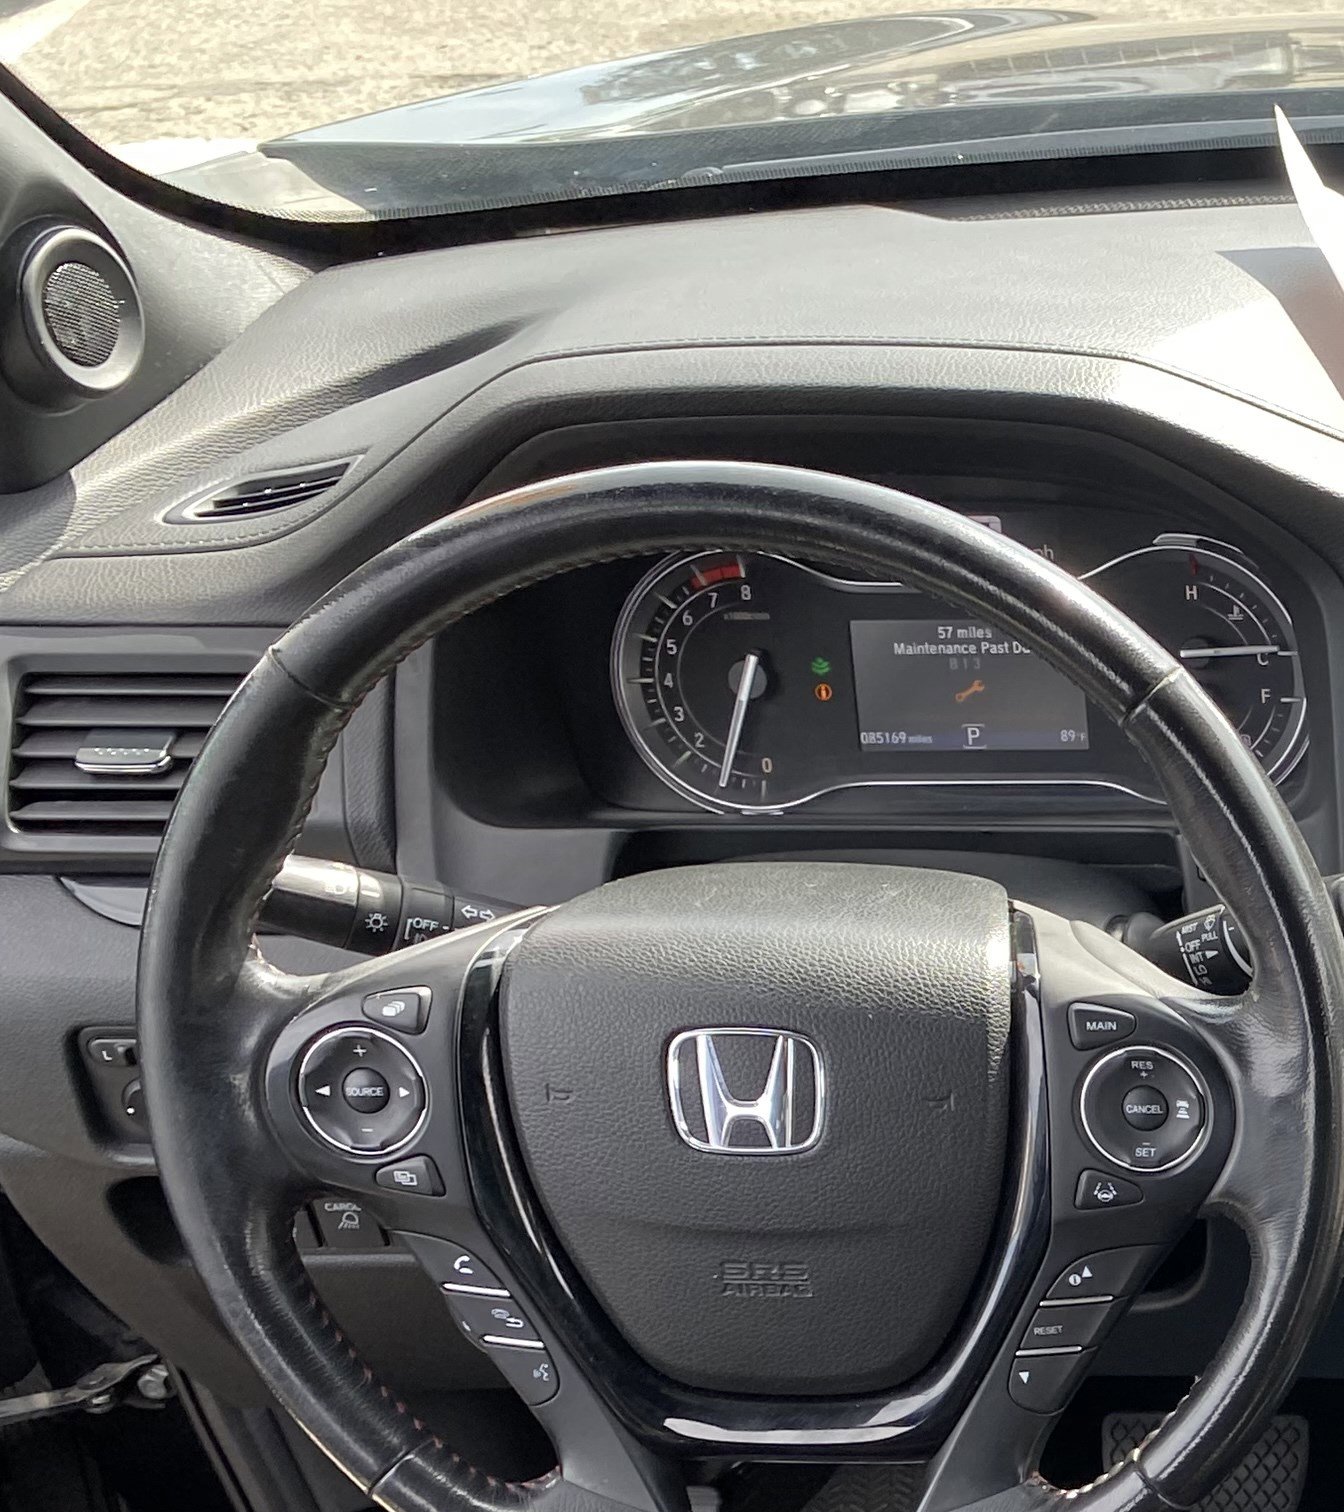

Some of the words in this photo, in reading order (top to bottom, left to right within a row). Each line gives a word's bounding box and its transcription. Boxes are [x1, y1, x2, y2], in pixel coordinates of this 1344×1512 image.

[740, 585, 751, 600] 8
[1185, 585, 1197, 600] H
[708, 592, 718, 608] 7
[682, 612, 693, 626] 6
[937, 626, 952, 639] 57
[957, 626, 992, 639] miles
[666, 639, 677, 654] 5
[894, 642, 976, 655] Maintenance
[981, 641, 1009, 654] Past
[664, 673, 673, 688] 4
[1260, 688, 1270, 703] F
[674, 706, 685, 722] 3
[694, 732, 705, 748] 2
[967, 727, 979, 745] P
[761, 757, 772, 773] 0
[413, 918, 439, 931] OFF
[1201, 931, 1218, 942] PULL
[1185, 939, 1200, 952] OFF
[1086, 1021, 1116, 1031] MAIN
[1131, 1060, 1153, 1070] RES
[346, 1087, 384, 1096] SOURCE
[1126, 1104, 1162, 1114] CANCEL
[1135, 1148, 1156, 1158] SET
[1034, 1324, 1063, 1335] RESET
